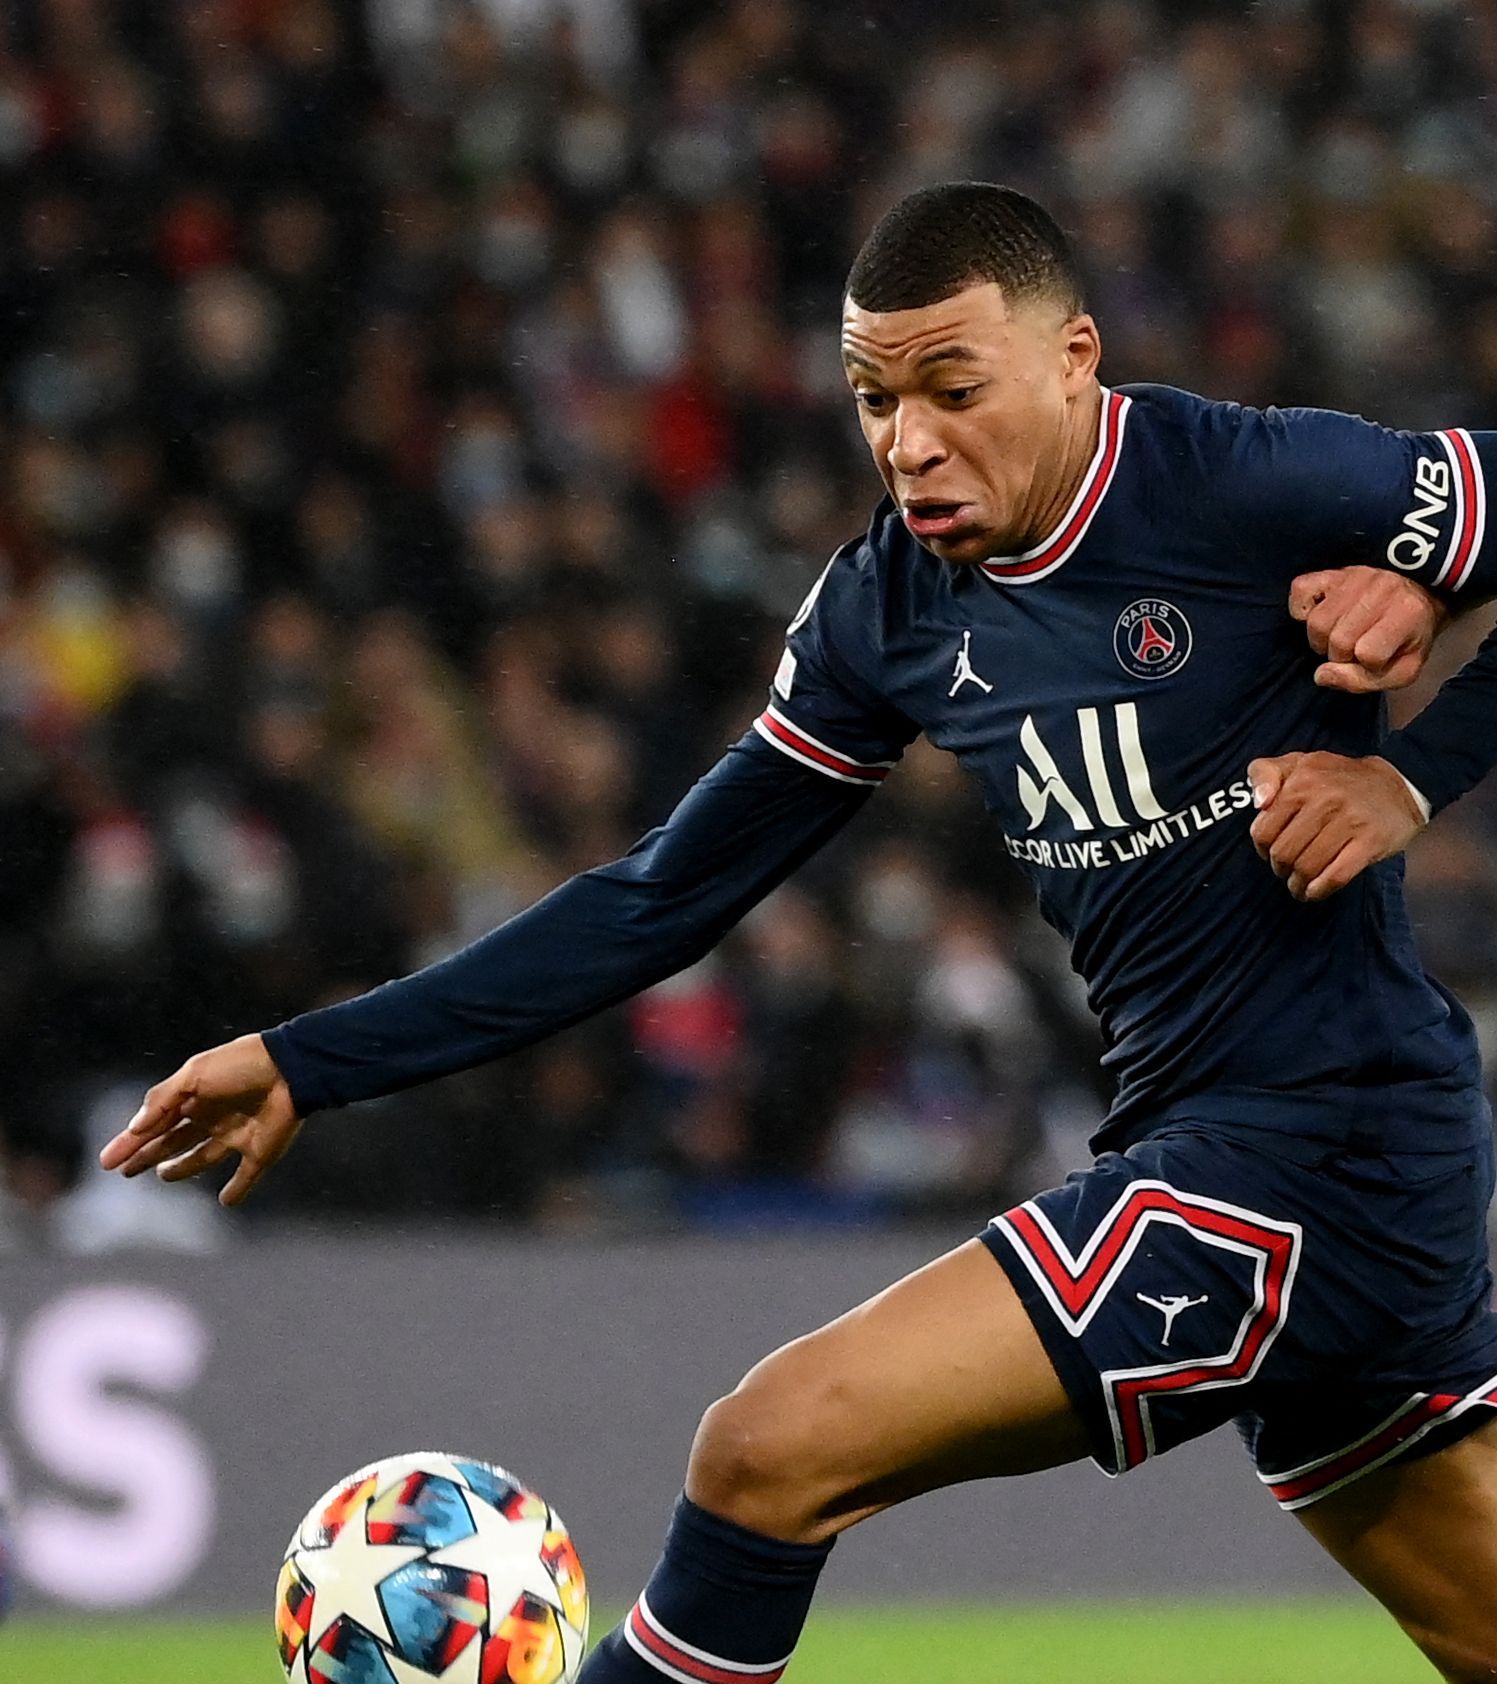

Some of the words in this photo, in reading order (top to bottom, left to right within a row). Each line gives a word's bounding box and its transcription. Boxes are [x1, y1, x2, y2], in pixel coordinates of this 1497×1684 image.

[1386, 456, 1450, 571] QNB
[1120, 603, 1170, 628] PARIS
[1003, 832, 1056, 869] CCOR
[1053, 840, 1112, 869] LIVE
[1109, 775, 1256, 863] LIMITLES
